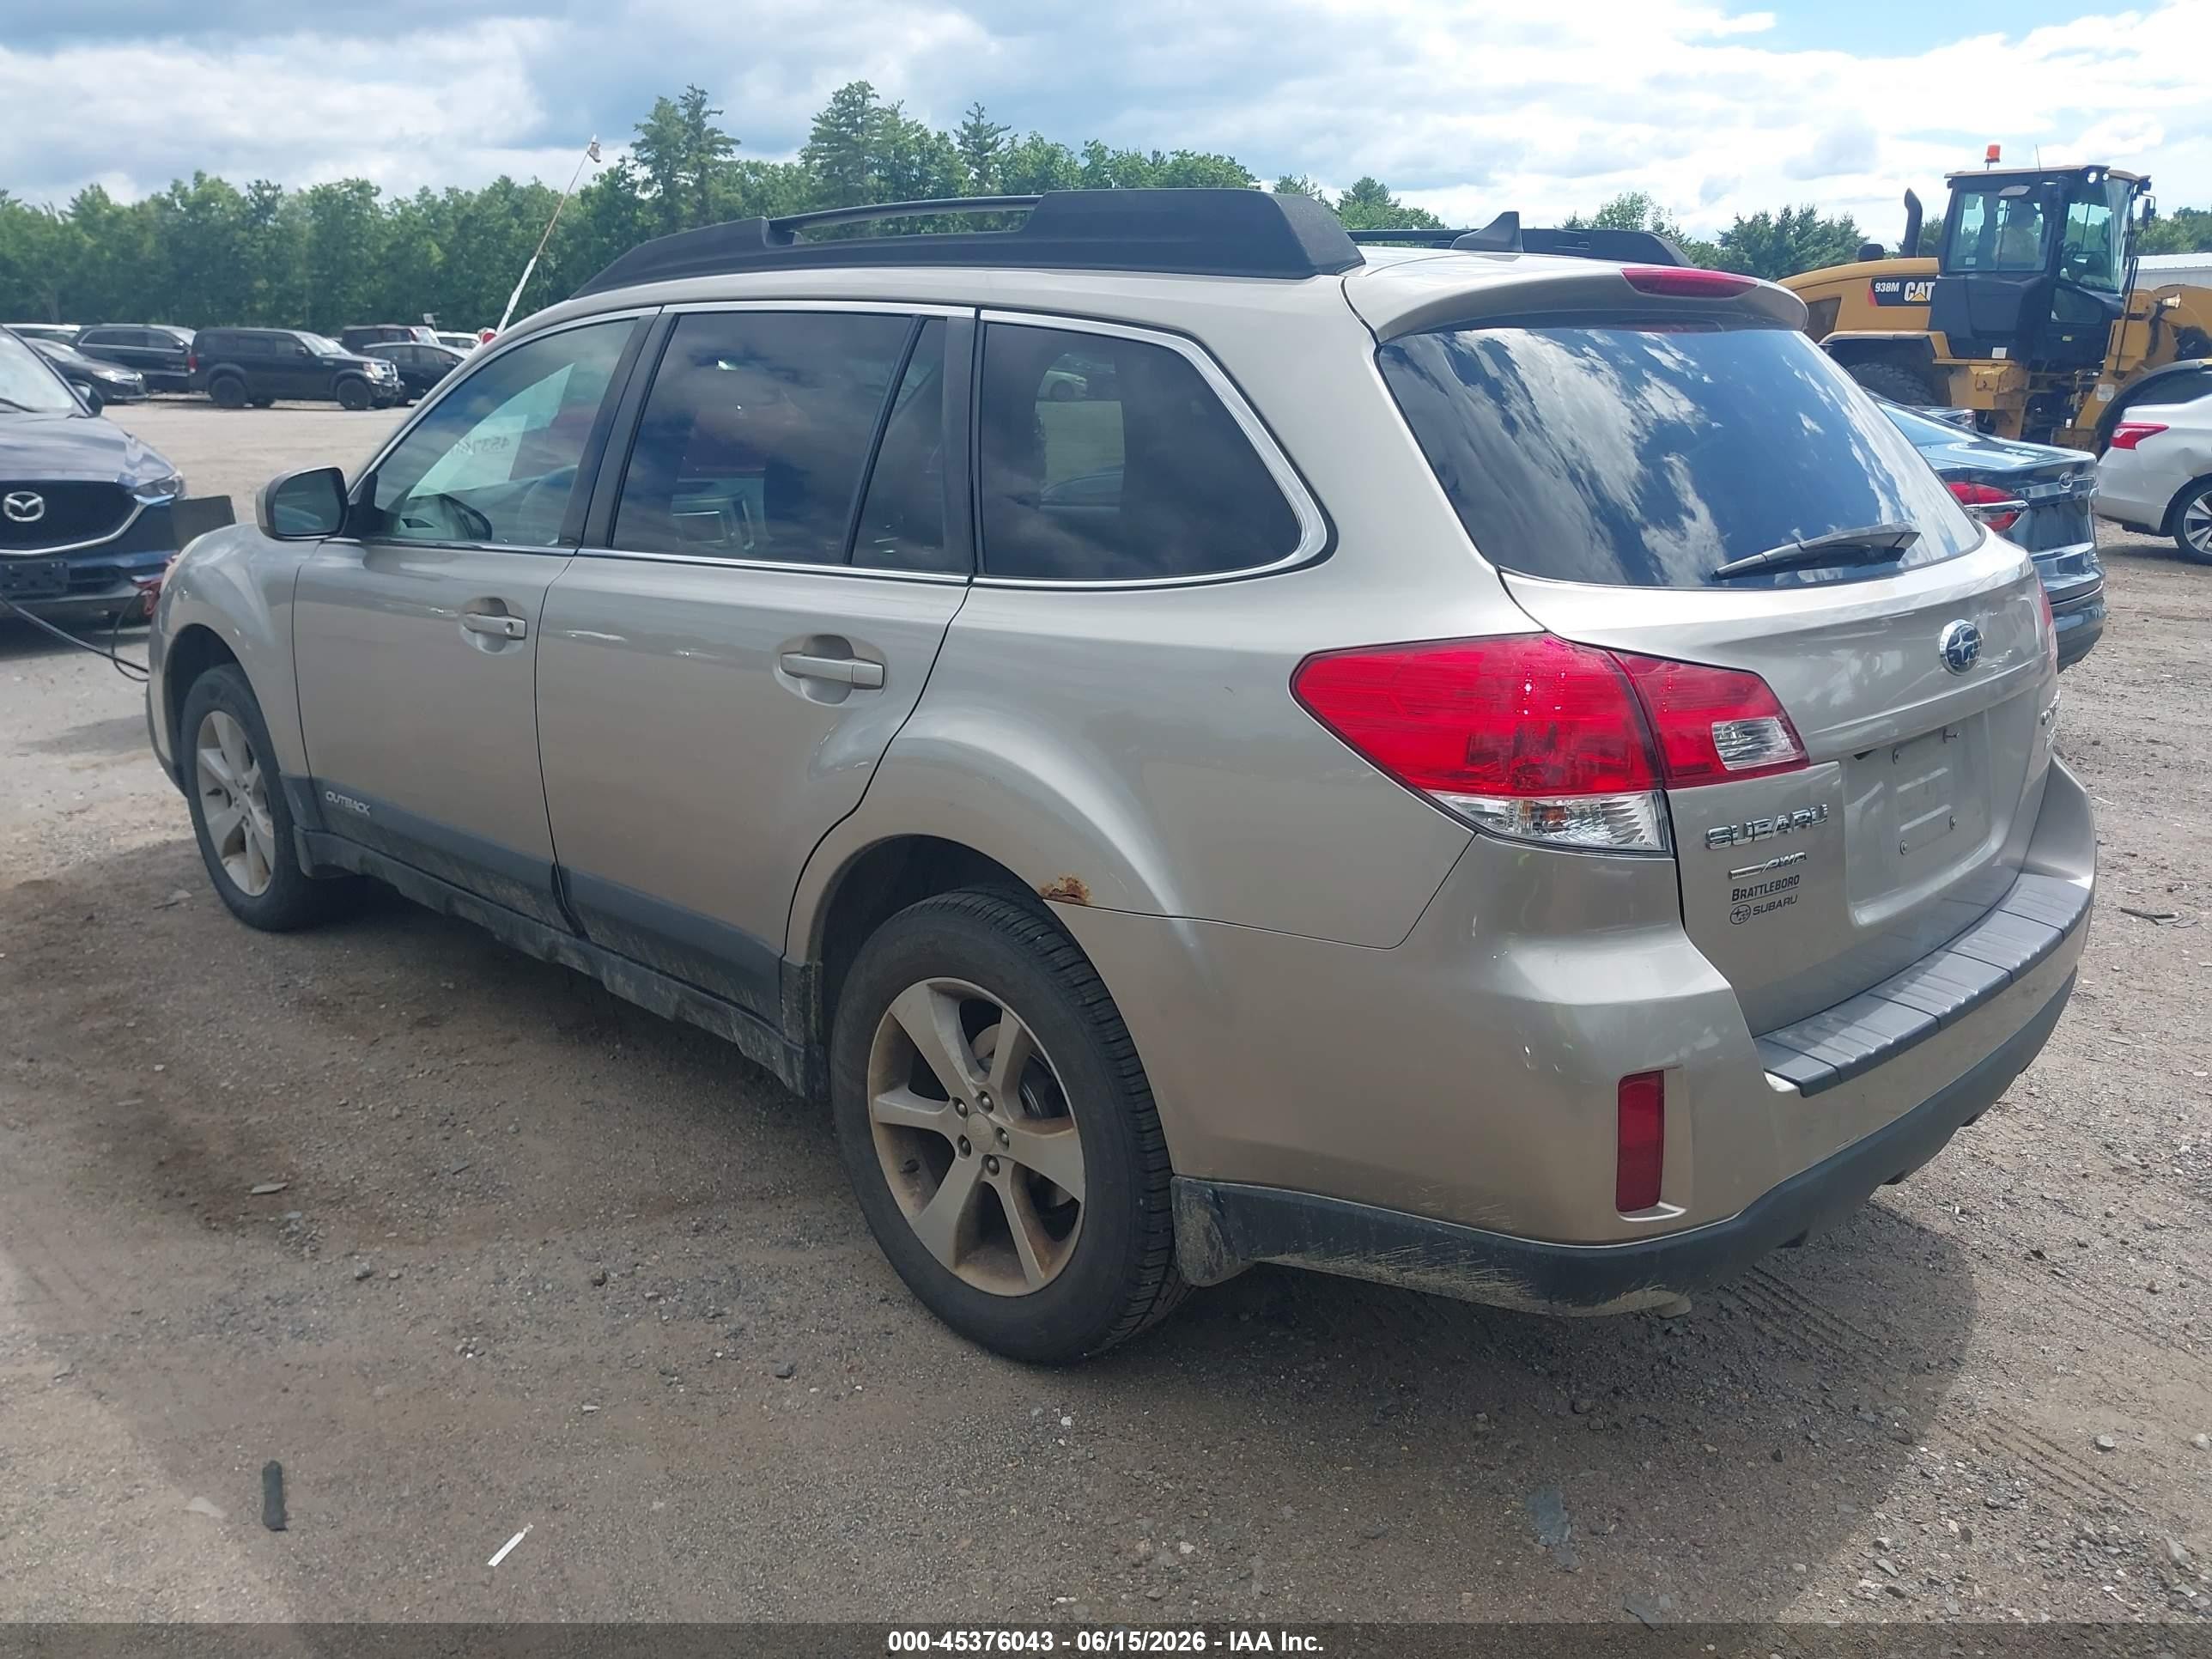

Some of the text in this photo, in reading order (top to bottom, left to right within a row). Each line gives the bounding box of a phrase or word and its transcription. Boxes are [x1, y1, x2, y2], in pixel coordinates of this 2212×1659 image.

[1875, 282, 1936, 301] 938M CAT
[1705, 804, 1828, 850] SUBARU
[1731, 874, 1800, 902] BRATTLEBORO
[1753, 894, 1799, 916] SUBARU
